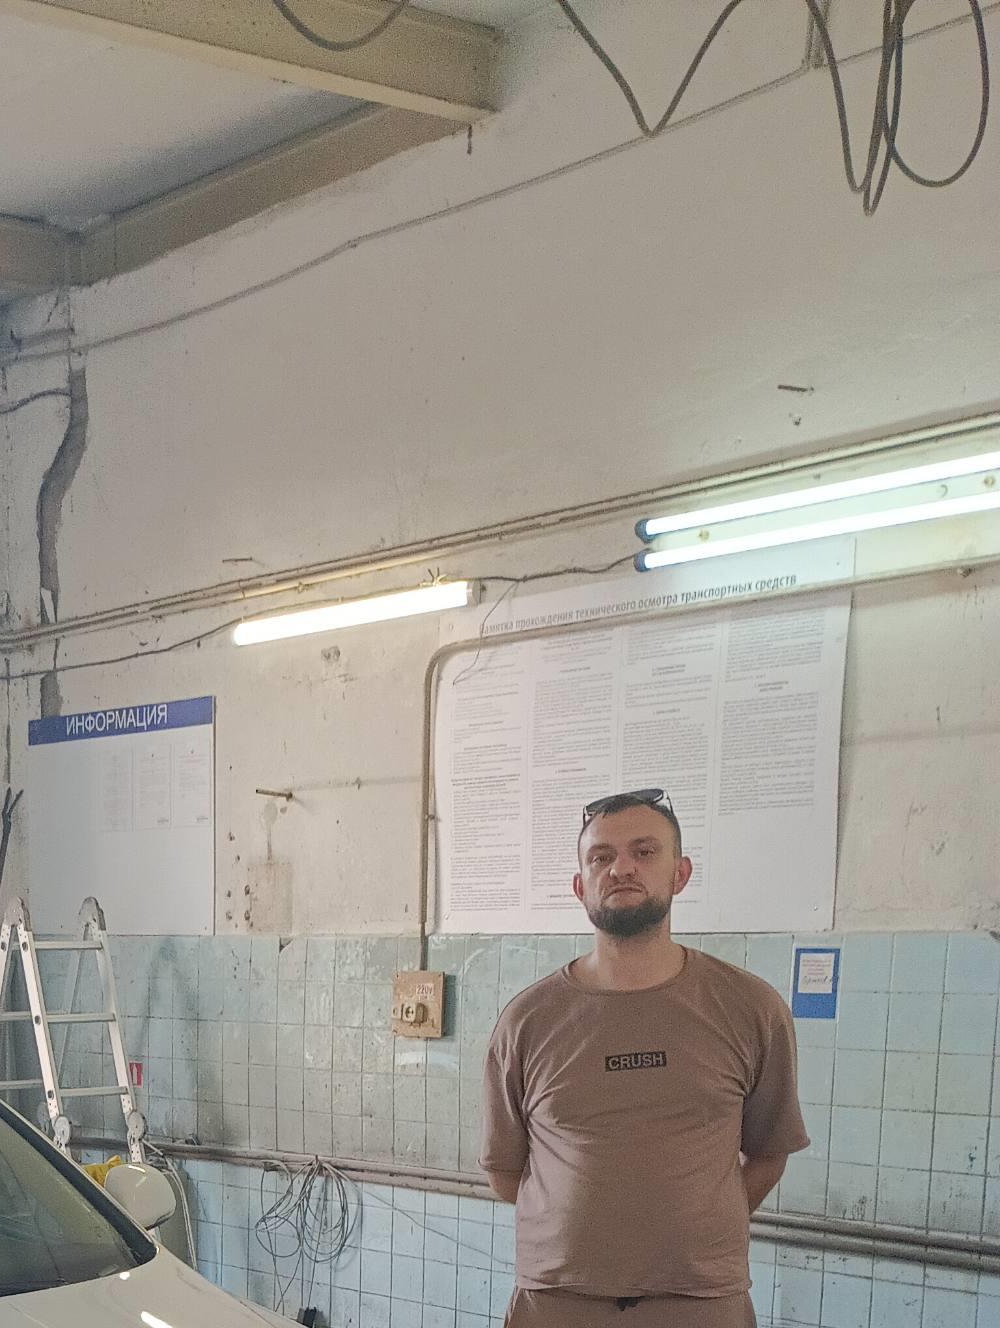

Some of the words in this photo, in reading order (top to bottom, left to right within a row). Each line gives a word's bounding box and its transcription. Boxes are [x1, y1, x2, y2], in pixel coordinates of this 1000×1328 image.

[515, 613, 573, 631] прохождения
[575, 600, 635, 619] технического
[638, 593, 677, 609] осмотра
[680, 583, 752, 604] транспортных
[755, 574, 797, 594] средств
[66, 703, 168, 736] ИНФОРМАЦИЯ
[608, 1053, 664, 1070] CRUSH
